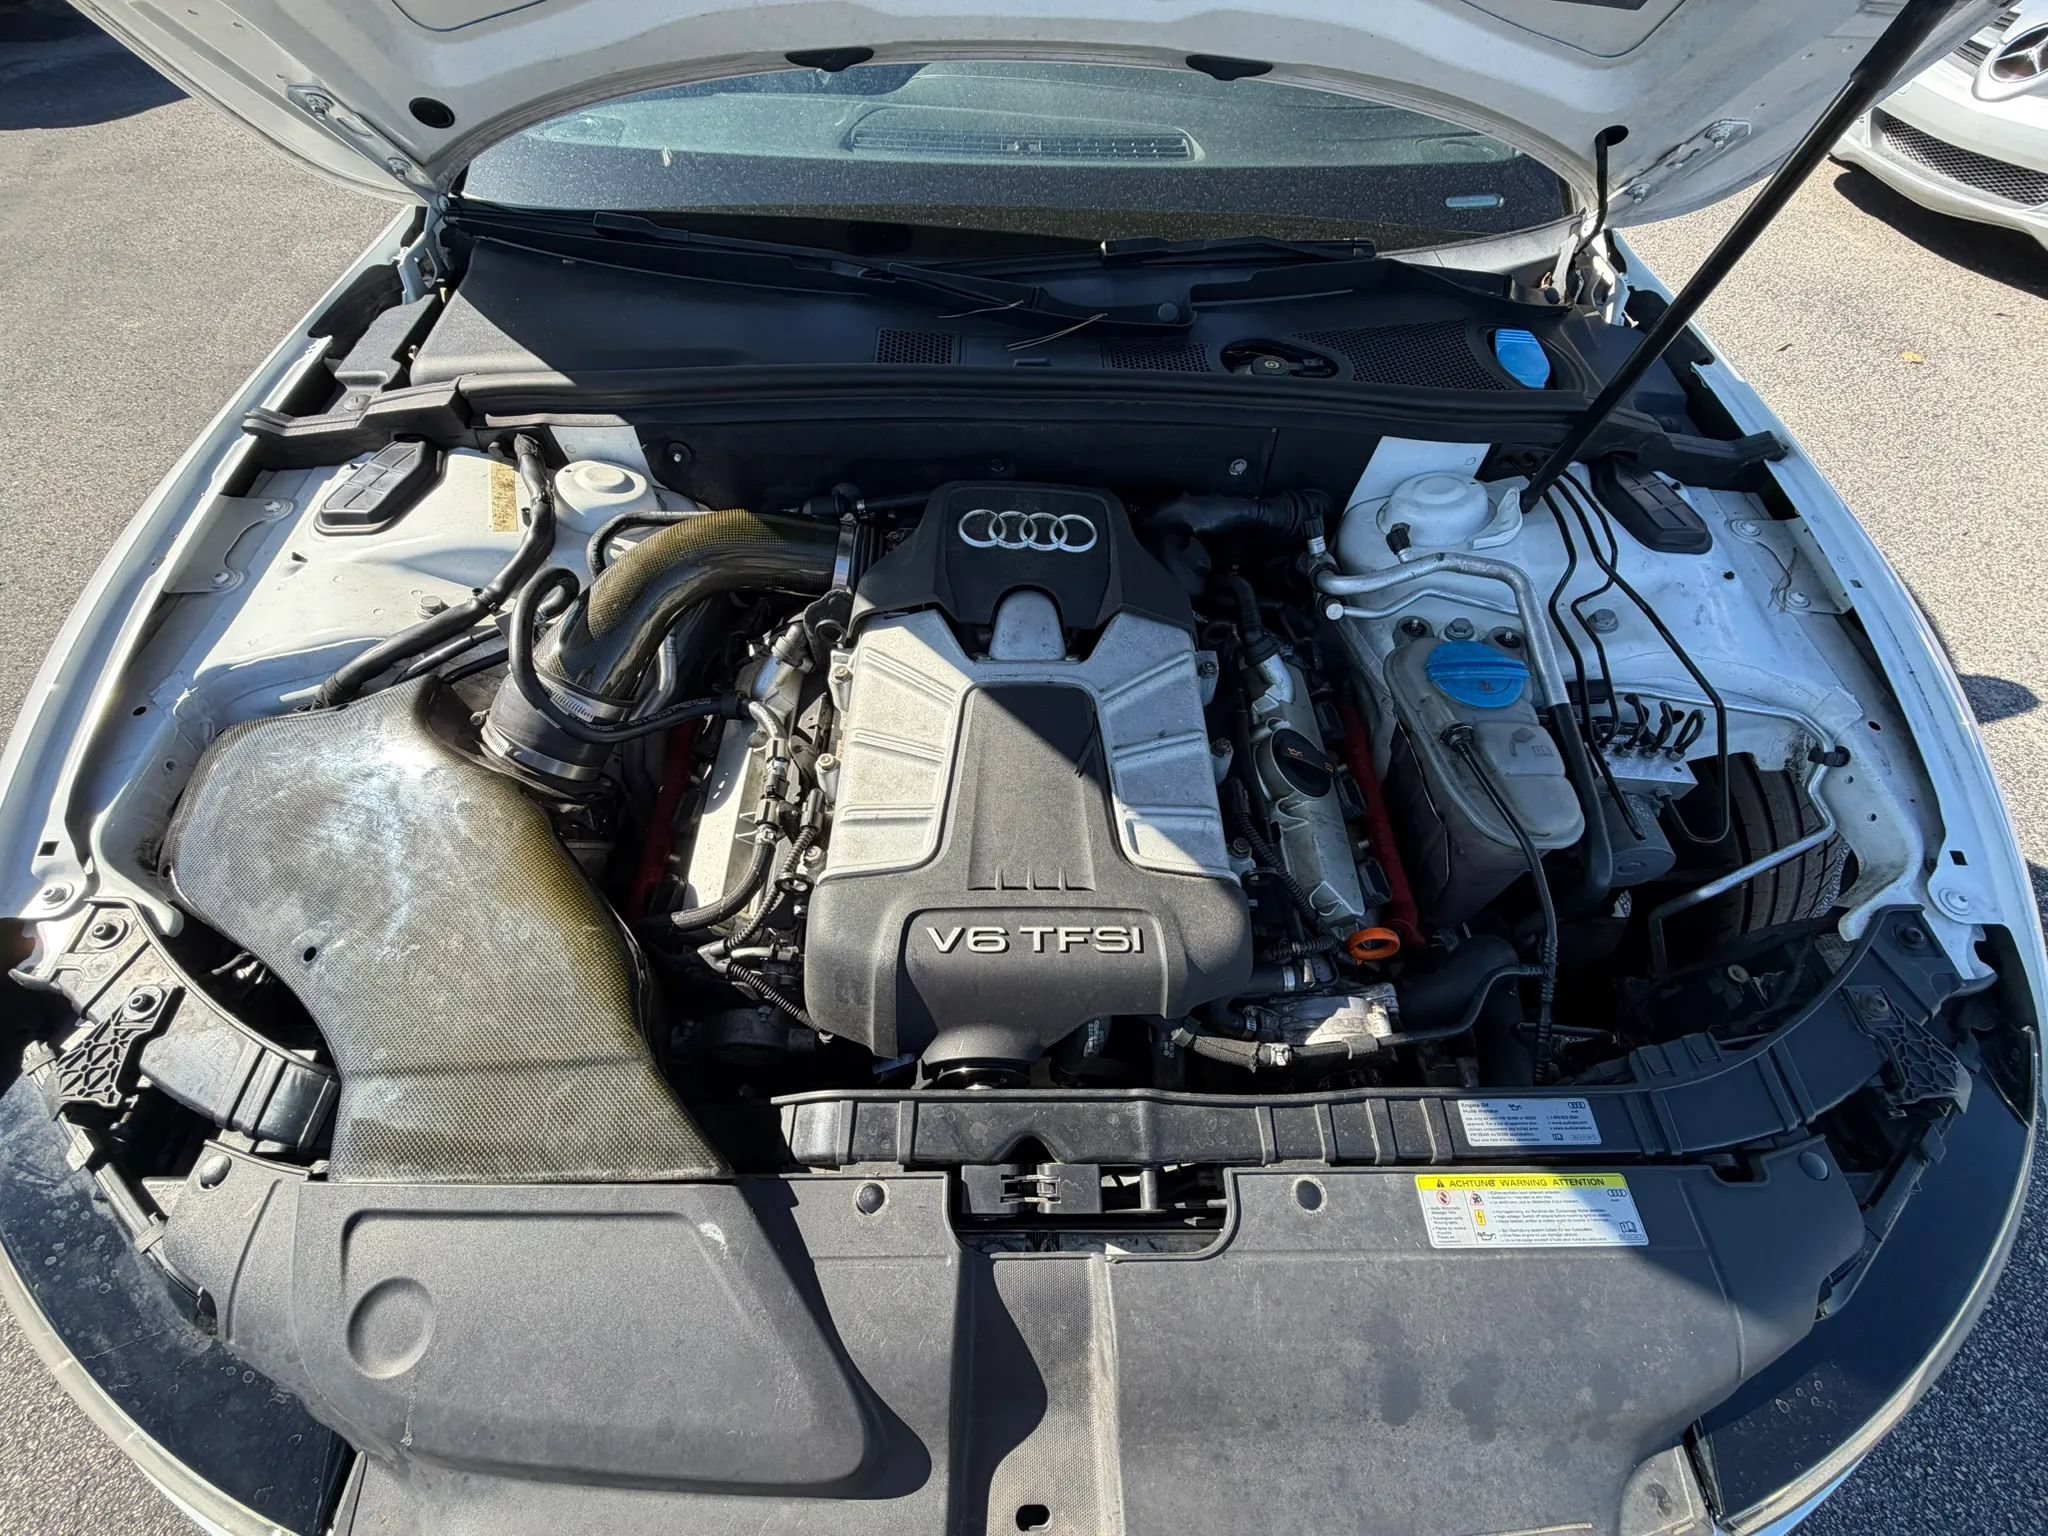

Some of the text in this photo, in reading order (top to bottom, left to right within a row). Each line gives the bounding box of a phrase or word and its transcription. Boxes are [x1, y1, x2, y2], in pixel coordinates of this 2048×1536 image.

[925, 926, 1144, 953] V6 TFSI
[1449, 1178, 1605, 1187] ACHTUNG WARNING ATTENTION
